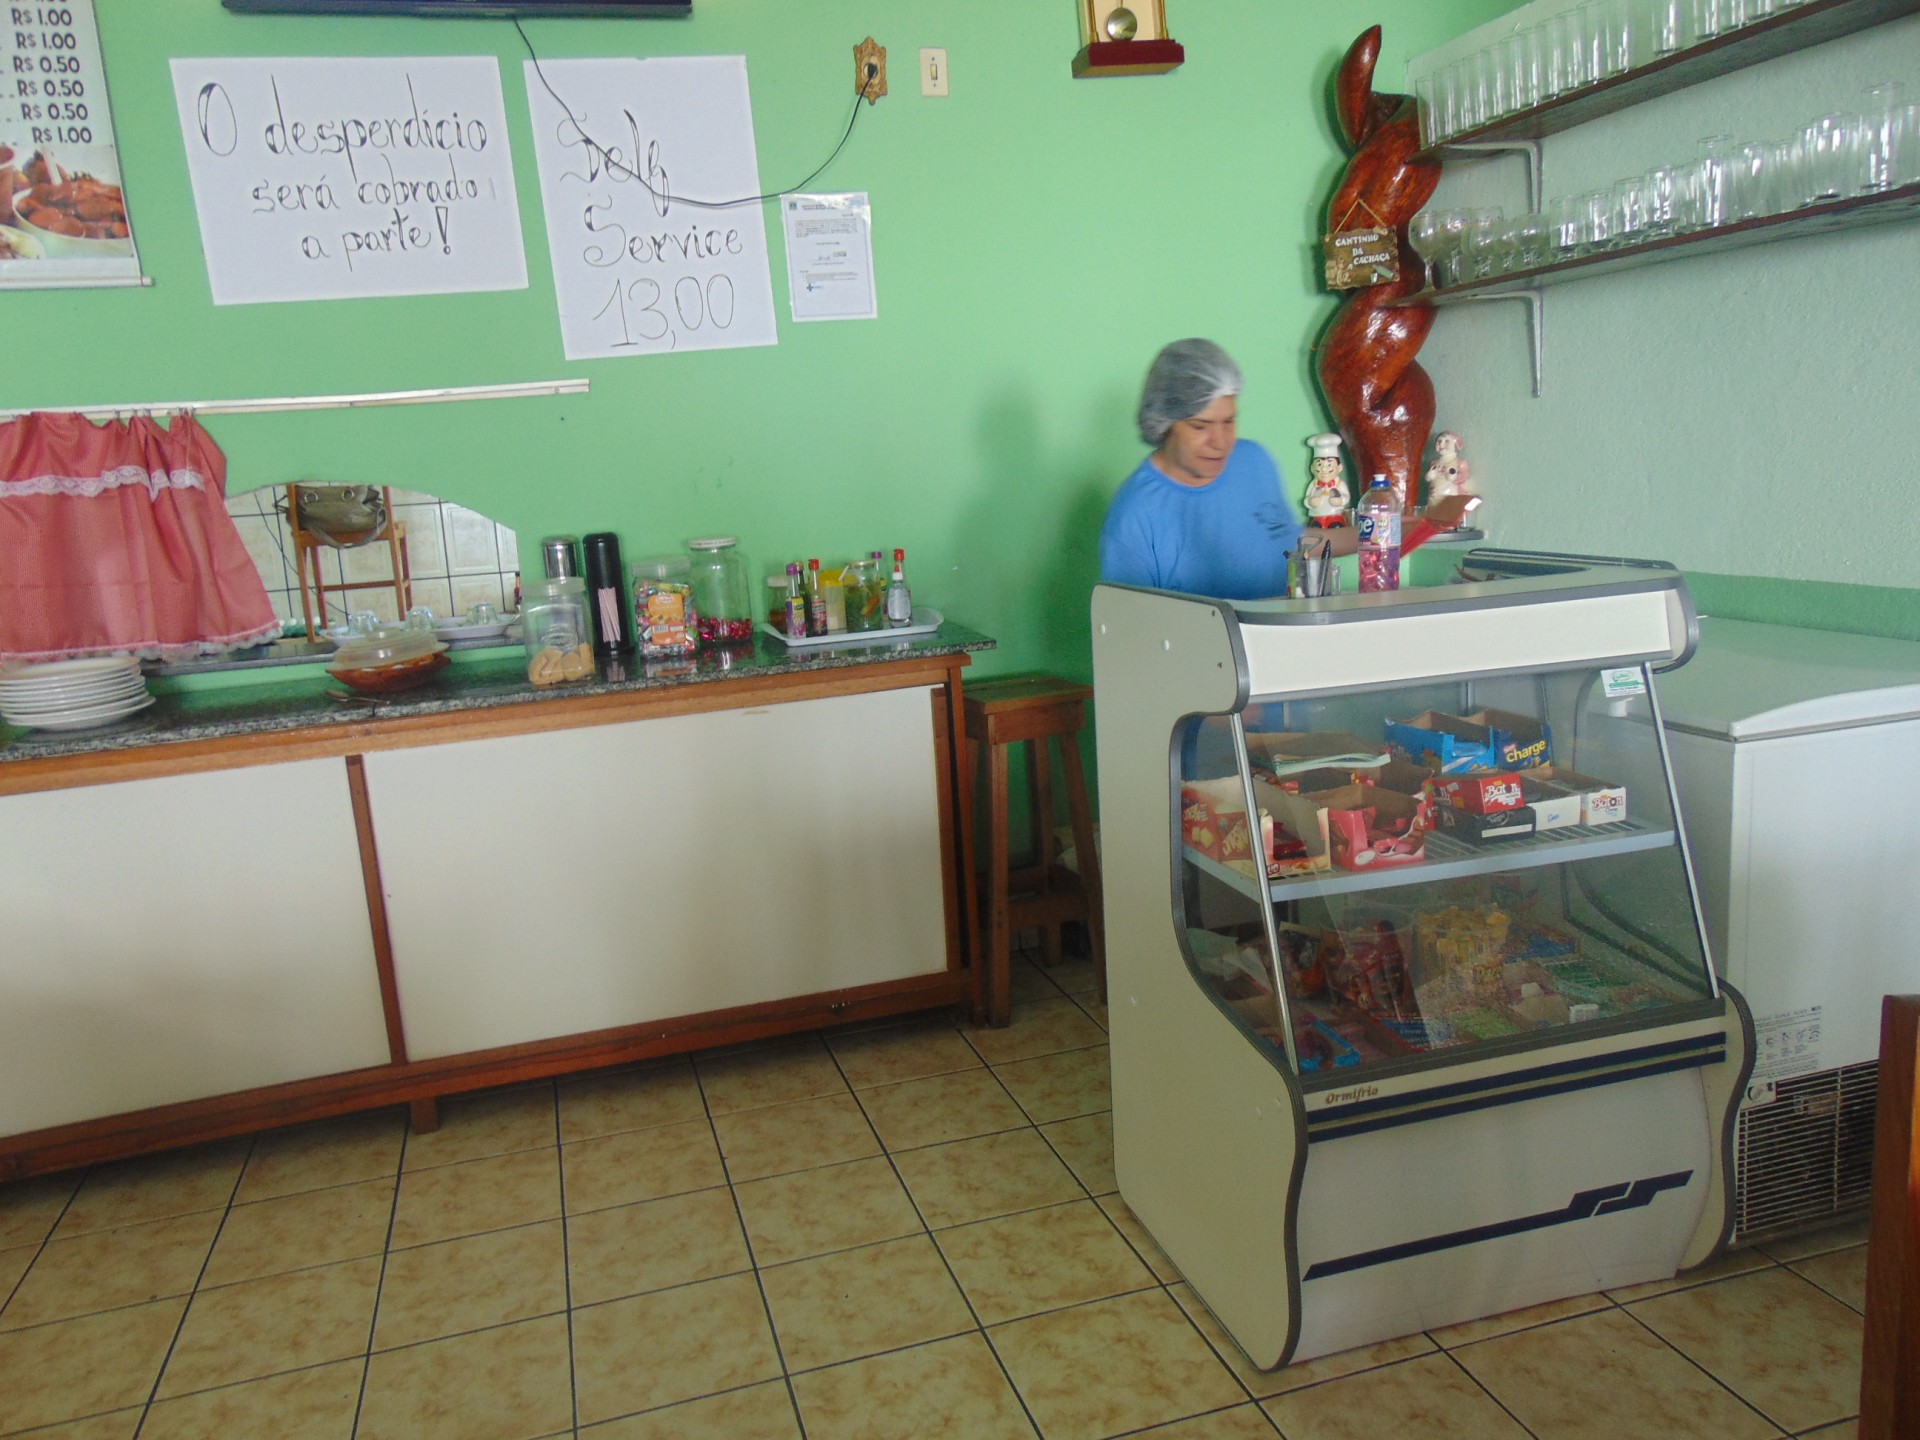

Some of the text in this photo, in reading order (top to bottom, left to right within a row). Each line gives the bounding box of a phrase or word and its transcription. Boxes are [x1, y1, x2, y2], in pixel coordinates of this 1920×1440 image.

[11, 7, 72, 26] R$ 1.00
[15, 31, 76, 50] R$ 1.00
[13, 56, 80, 73] R$ 0.50
[17, 79, 84, 97] R$ 0.50
[21, 103, 88, 120] R$ 0.50
[198, 82, 237, 156] O
[31, 126, 92, 144] R$ 1.00
[557, 108, 670, 217] Self
[253, 153, 478, 213] será cobrado
[302, 206, 451, 272] a parte!
[583, 194, 743, 267] Service
[1335, 234, 1379, 247] CANTINHO
[1352, 247, 1363, 257] DA
[592, 274, 735, 350] 13,00
